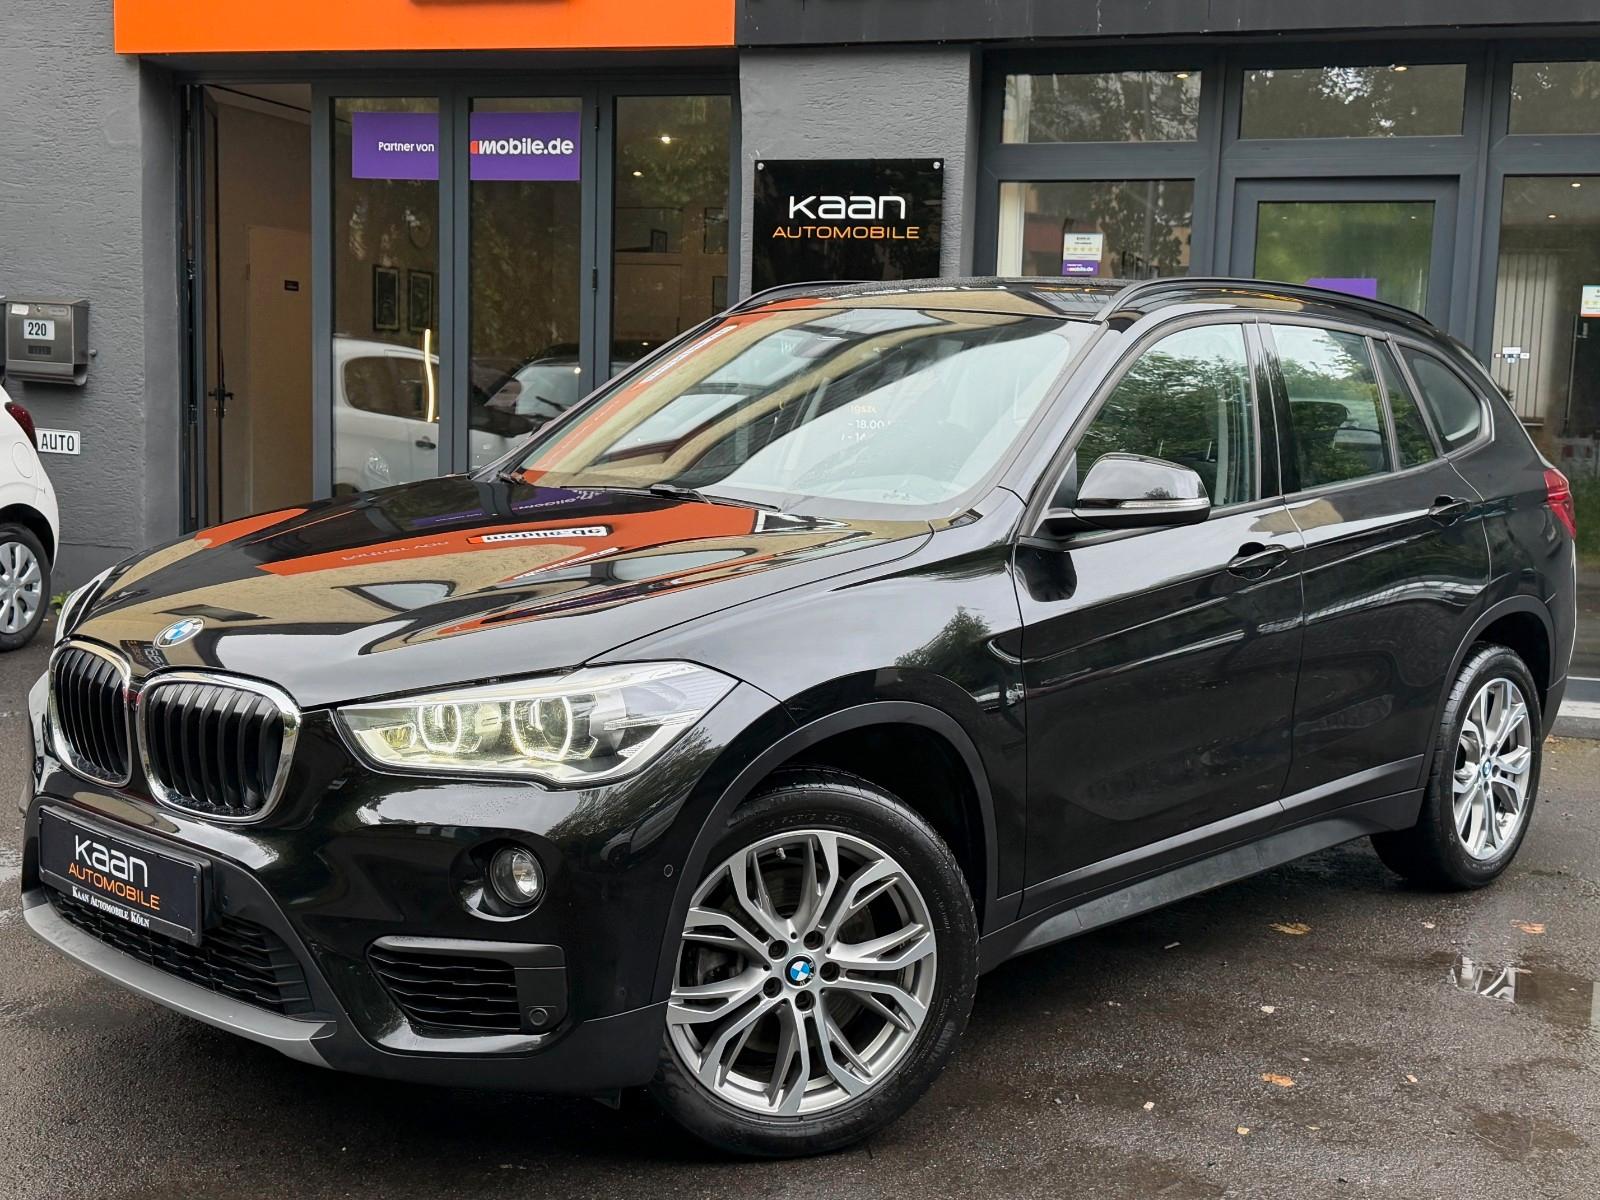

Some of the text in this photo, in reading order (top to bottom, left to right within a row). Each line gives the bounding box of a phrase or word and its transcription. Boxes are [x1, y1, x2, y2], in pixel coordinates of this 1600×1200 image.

[378, 141, 435, 152] Partner von
[478, 137, 574, 155] mobile.de
[772, 226, 920, 239] AUTOMOBILE
[27, 321, 47, 337] 220
[41, 433, 75, 451] AUTO
[75, 835, 148, 888] kaan
[68, 862, 161, 911] AUTOMOBILE
